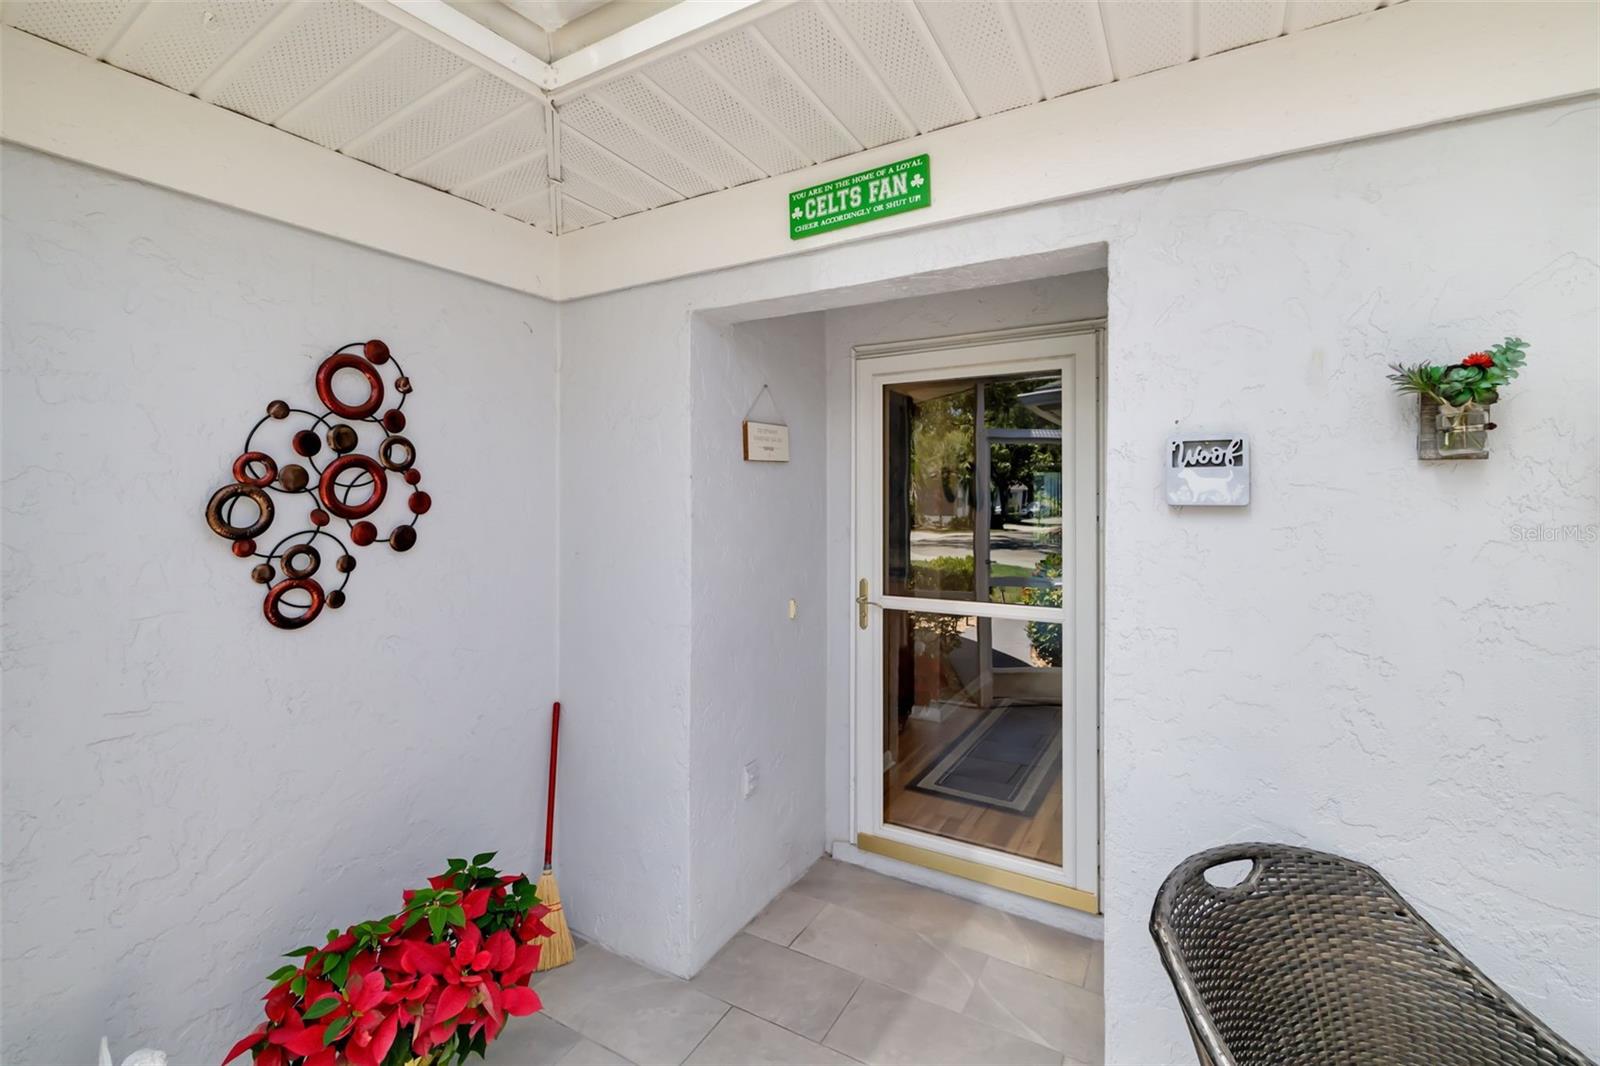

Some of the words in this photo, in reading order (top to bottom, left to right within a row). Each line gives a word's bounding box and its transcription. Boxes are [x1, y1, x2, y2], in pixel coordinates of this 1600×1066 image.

[792, 193, 807, 201] YOU
[808, 188, 823, 197] ARE
[824, 184, 835, 192] IN
[835, 179, 850, 189] THE
[851, 172, 875, 185] HOME
[876, 169, 887, 177] OF
[896, 159, 923, 172] LOYAL
[805, 186, 862, 219] CELTS
[868, 172, 908, 203] FAN
[794, 221, 820, 233] CHEER
[820, 207, 872, 227] ACCORDINGLY
[873, 203, 885, 212] OR
[885, 198, 907, 210] SHUT
[1171, 439, 1243, 468] Woof
